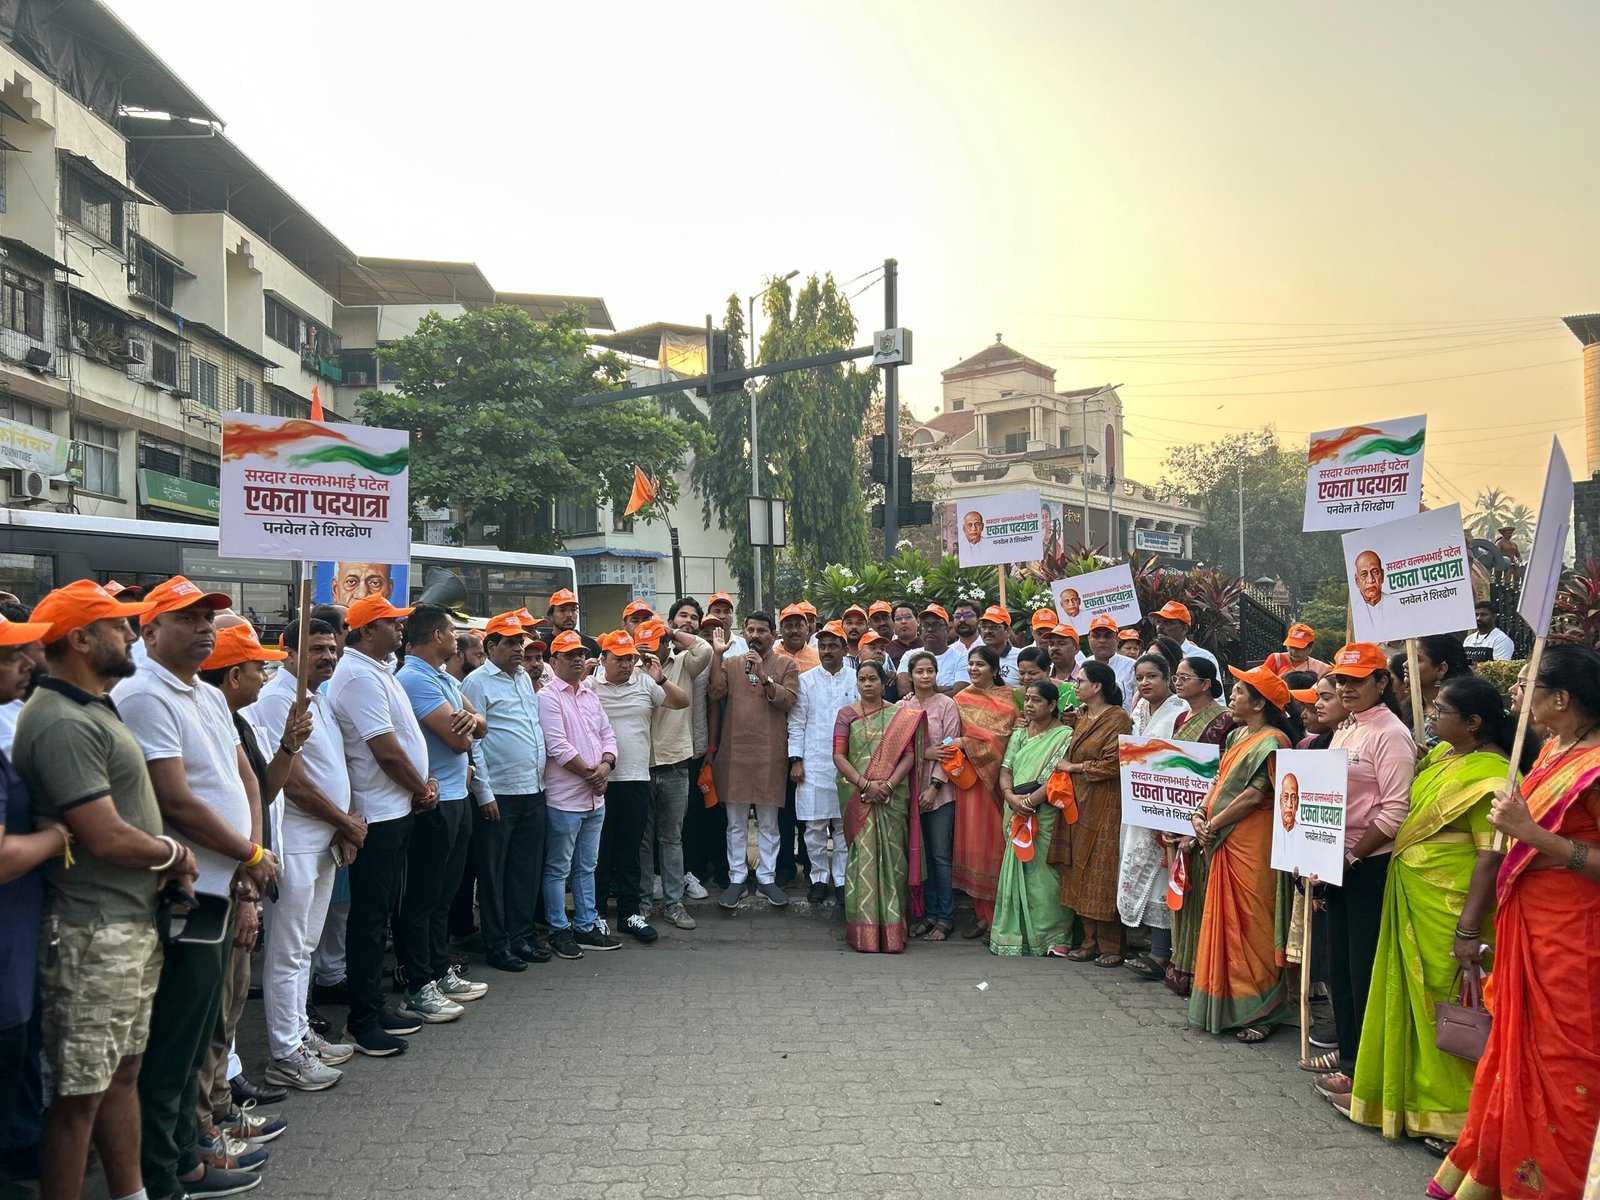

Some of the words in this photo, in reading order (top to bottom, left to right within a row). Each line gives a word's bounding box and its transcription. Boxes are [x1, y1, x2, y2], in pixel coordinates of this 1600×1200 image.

[1, 446, 32, 462] FURNITURE
[1319, 468, 1342, 478] सरदार
[1344, 462, 1386, 476] वल्लभभाई
[1388, 458, 1409, 470] पटेल
[245, 470, 286, 484] सरदार
[290, 473, 356, 491] वल्लभभाई
[359, 475, 389, 491] पटेल
[1318, 477, 1354, 500] एकता
[1356, 472, 1409, 495] पदयात्रा
[244, 486, 308, 513] एकता
[311, 491, 390, 518] पदयात्रा
[1327, 502, 1352, 514] पनवेल
[1353, 503, 1360, 512] ते
[1361, 500, 1394, 511] शिरढोण
[263, 519, 306, 535] पनवेल
[310, 521, 320, 535] ते
[322, 522, 372, 538] शिरढोण
[986, 517, 999, 525] सरदार
[986, 523, 1008, 536] एकता
[1009, 520, 1038, 533] पदयात्रा
[1386, 560, 1406, 571] सरदार
[1407, 549, 1443, 566] वल्लभभाई
[1444, 546, 1461, 558] पटेल
[1387, 568, 1418, 590] एकता
[1420, 558, 1464, 581] पदयात्रा
[1083, 597, 1105, 608] एकता
[1106, 590, 1133, 605] पदयात्रा
[1400, 594, 1422, 605] पनवेल
[1422, 593, 1429, 601] ते
[1430, 587, 1457, 600] शिरढोण
[1131, 771, 1152, 780] सरदार
[1153, 774, 1190, 788] वल्लभभाई
[1191, 779, 1209, 789] पटेल
[1131, 782, 1164, 802] एकता
[1301, 791, 1313, 802] सरदार
[1314, 791, 1333, 803] वल्लभभाई
[1334, 792, 1343, 802] पटेल
[1142, 805, 1164, 816] पनवेल
[1166, 808, 1171, 817] ते
[1301, 804, 1319, 820] एकता
[1320, 805, 1342, 826] पदयात्रा
[1305, 831, 1318, 841] पनवेल
[1319, 832, 1322, 841] ते
[1322, 832, 1336, 844] शिरढोण
